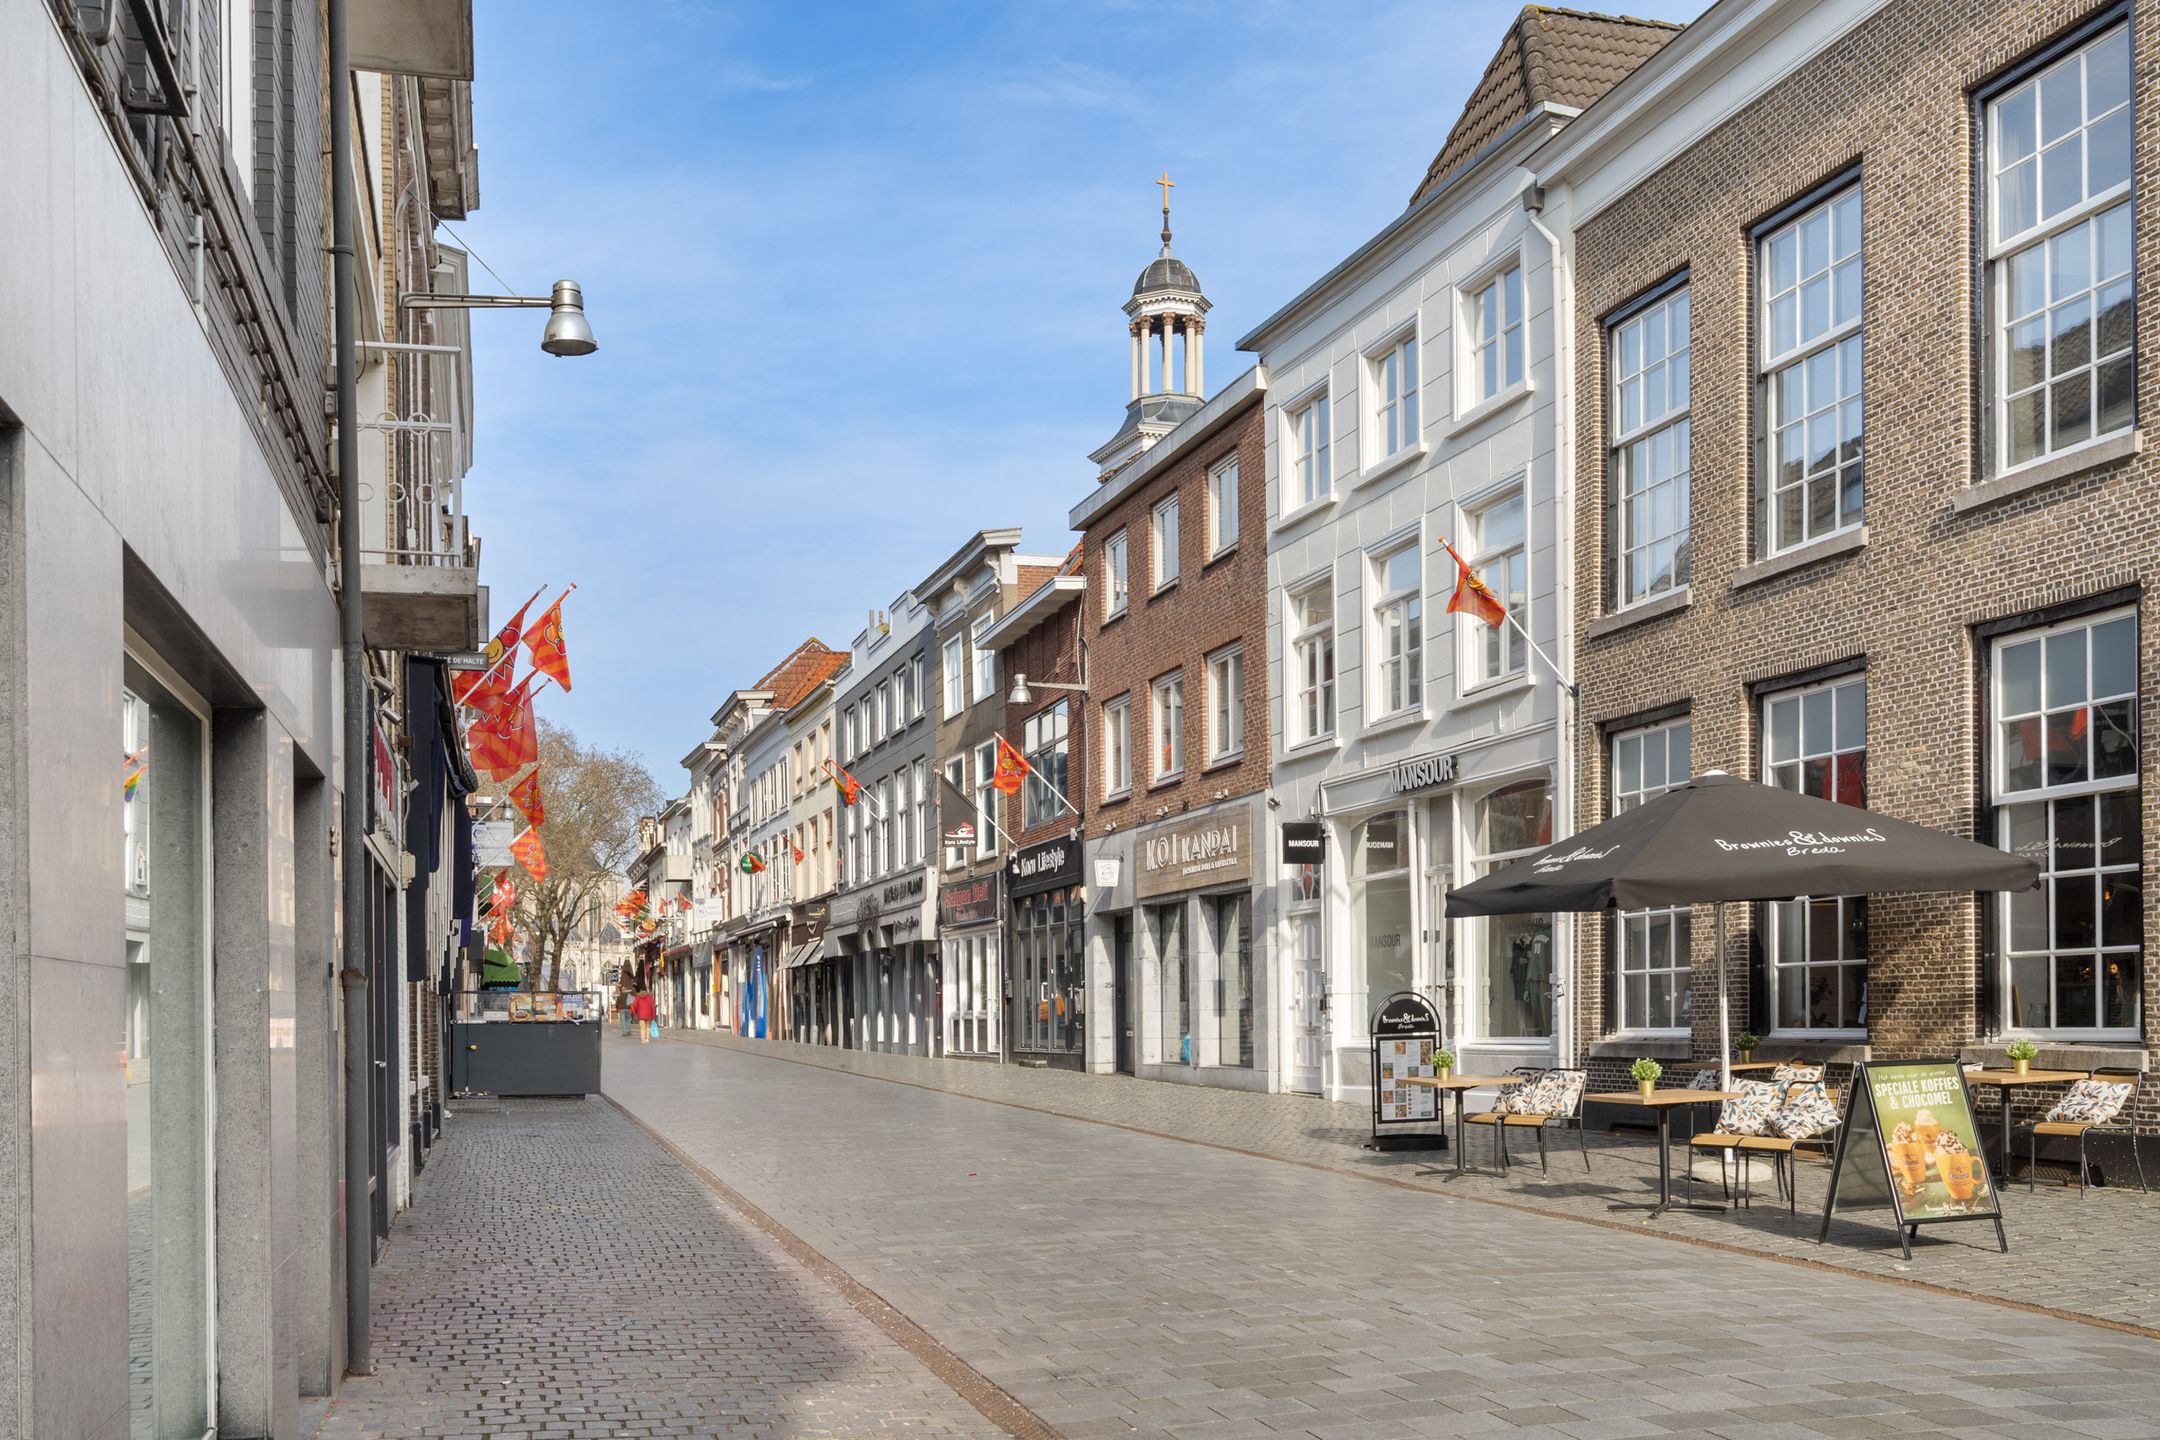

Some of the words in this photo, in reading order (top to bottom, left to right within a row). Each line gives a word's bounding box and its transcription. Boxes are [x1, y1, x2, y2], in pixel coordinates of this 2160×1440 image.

[463, 657, 485, 665] HALTE
[1390, 755, 1456, 793] MANSOUR
[1181, 825, 1237, 863] KANPAI
[1288, 839, 1320, 848] MANSOUR
[1786, 846, 1846, 856] Breda
[1021, 858, 1036, 877] Koru
[1037, 847, 1065, 873] Lifestyle
[944, 887, 972, 910] Saigon
[972, 880, 989, 902] Deli
[1875, 1080, 1919, 1097] SPECIALE
[1921, 1076, 1960, 1091] KOFFIES
[1889, 1095, 1899, 1110] &
[1902, 1091, 1953, 1109] CHOCOMEL
